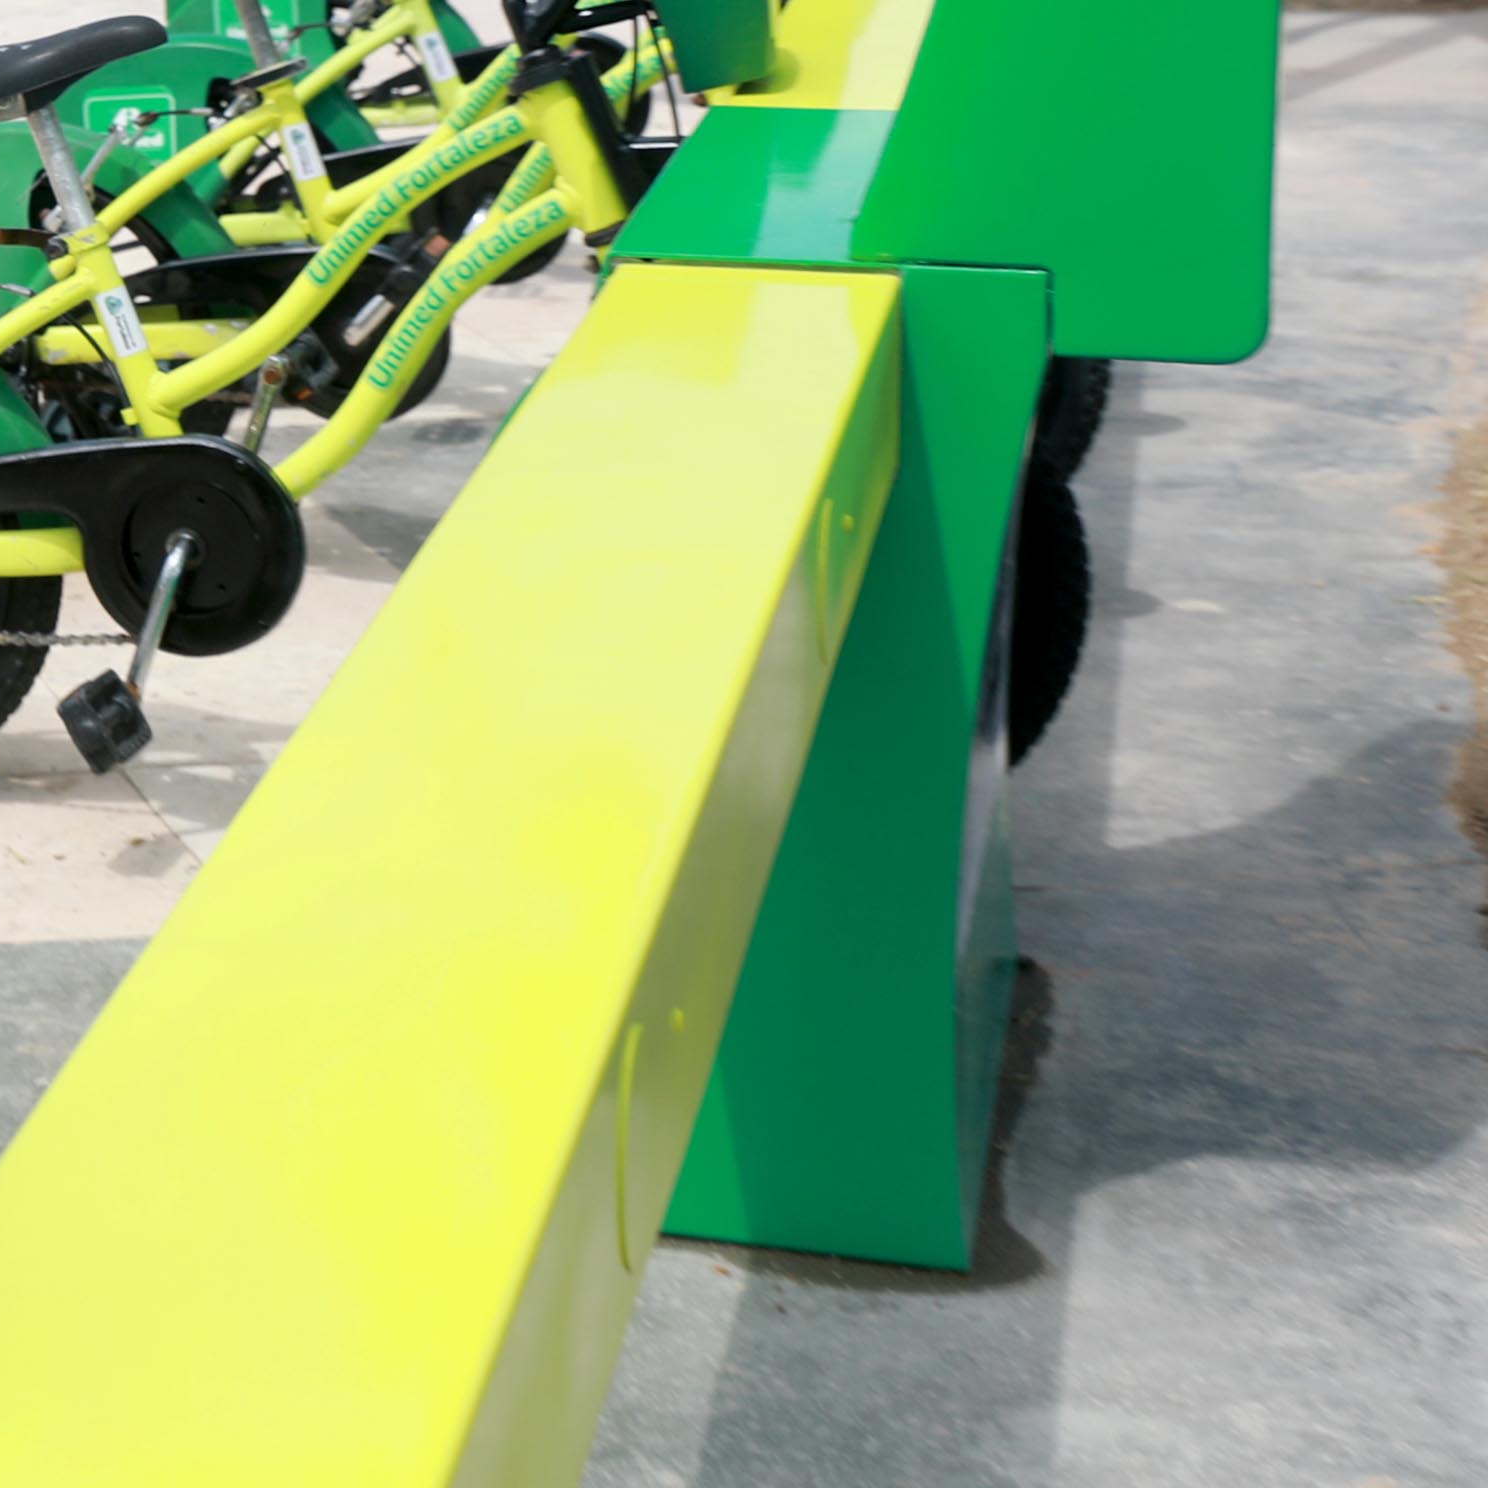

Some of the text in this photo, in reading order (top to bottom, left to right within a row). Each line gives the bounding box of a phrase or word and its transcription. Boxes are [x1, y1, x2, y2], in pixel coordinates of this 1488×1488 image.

[307, 114, 526, 287] Unimed Fortaleza
[368, 199, 565, 390] Unimed Fortaleza
